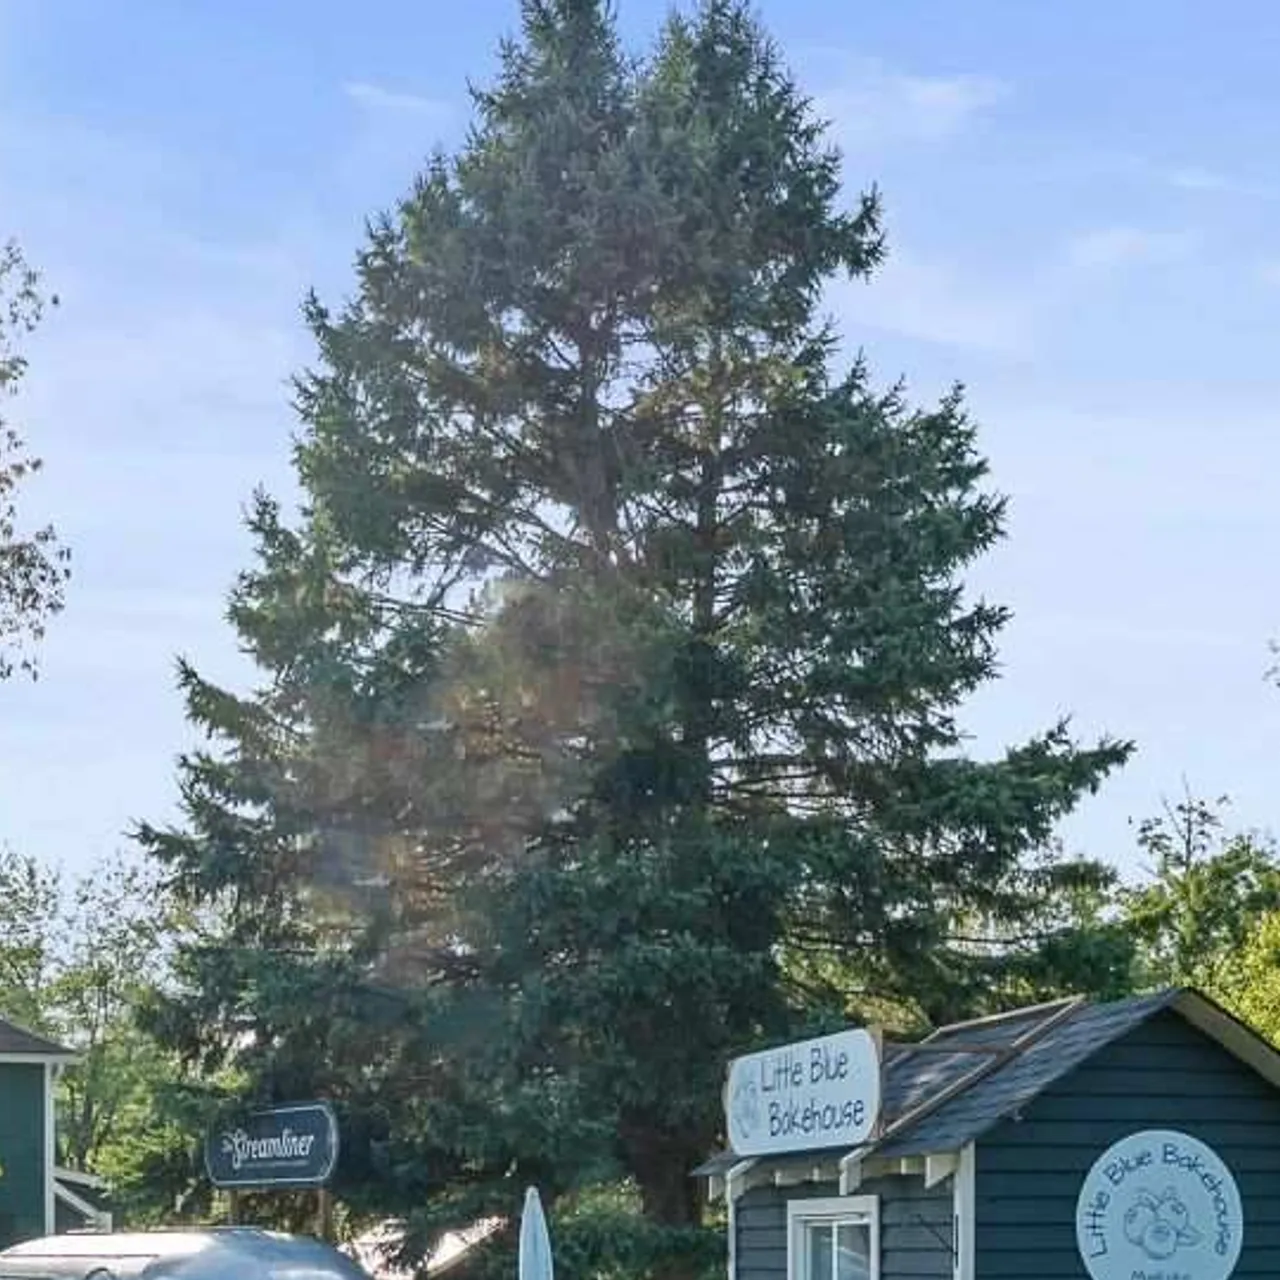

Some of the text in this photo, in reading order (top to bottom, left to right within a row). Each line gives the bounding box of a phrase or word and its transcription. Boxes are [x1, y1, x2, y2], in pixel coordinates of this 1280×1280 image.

[761, 1044, 848, 1092] Little Blue
[770, 1098, 864, 1137] Bakehouse
[232, 1128, 315, 1170] Streamliner
[1085, 1142, 1232, 1258] Little Blue Bakehouse
